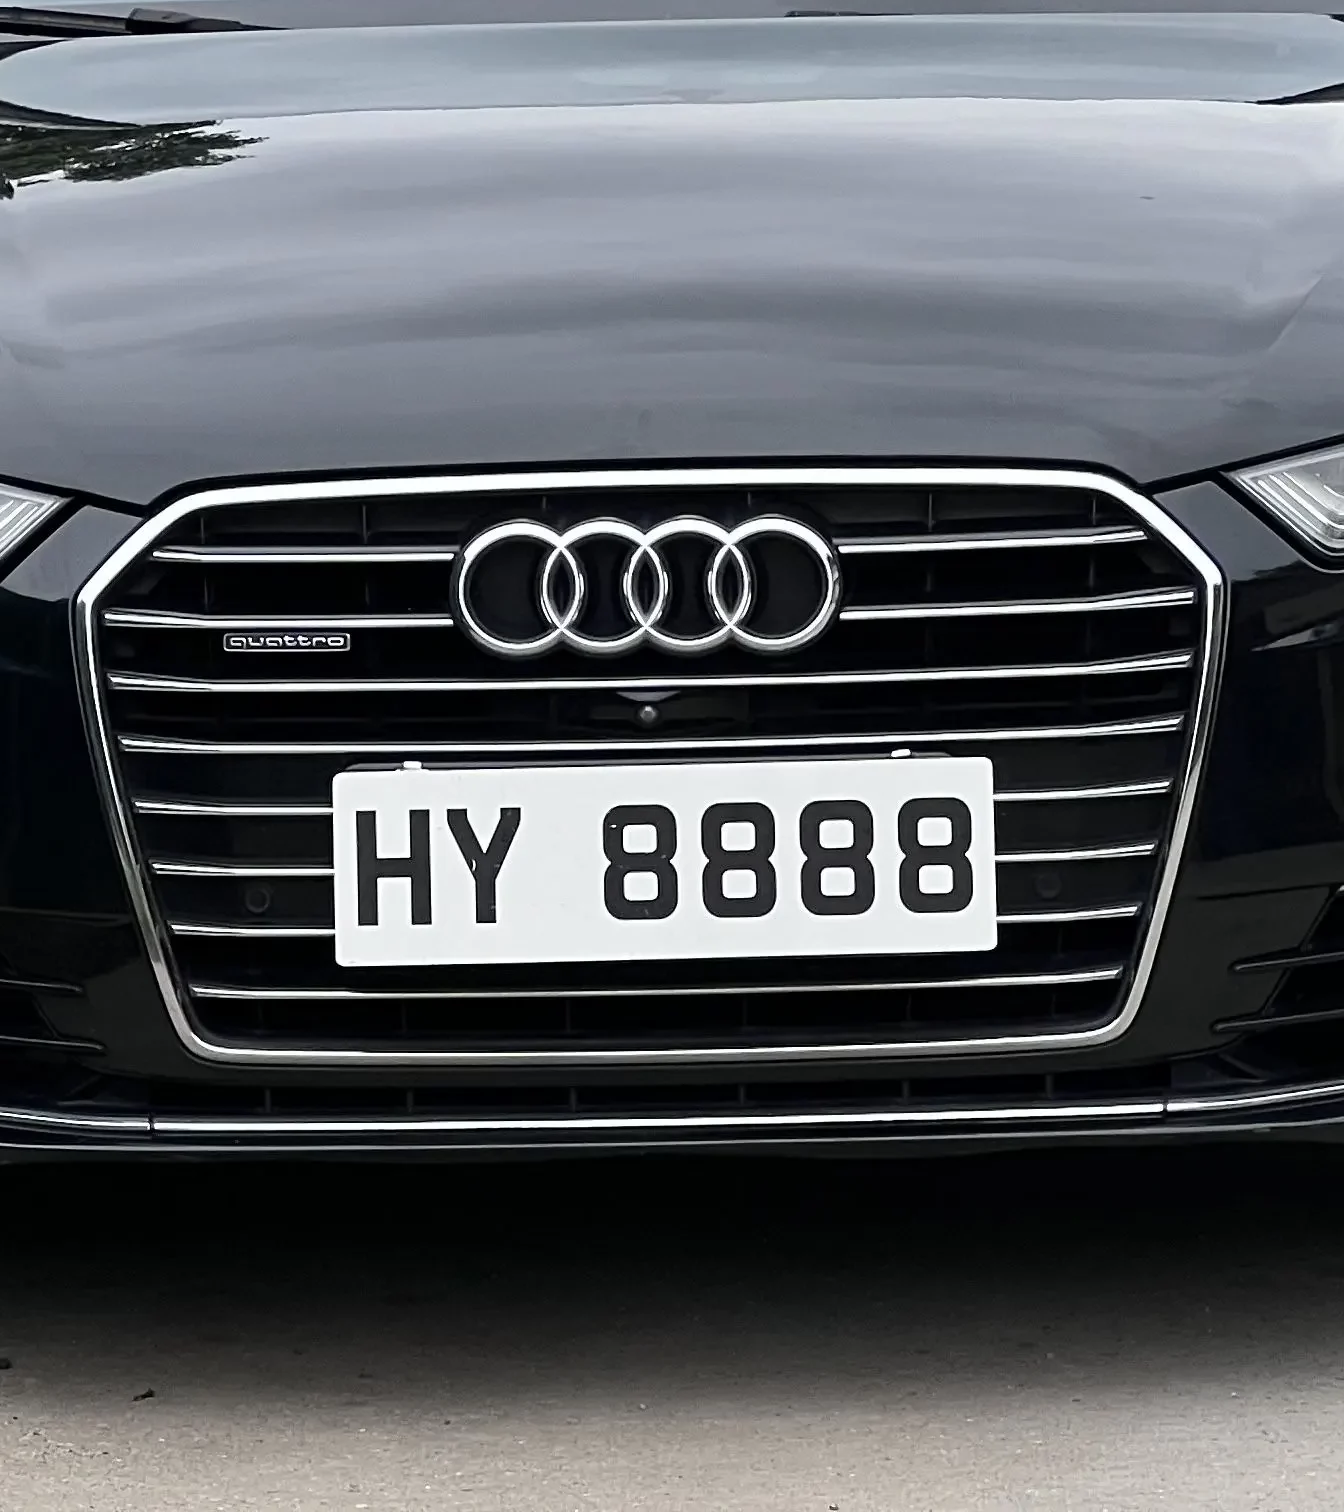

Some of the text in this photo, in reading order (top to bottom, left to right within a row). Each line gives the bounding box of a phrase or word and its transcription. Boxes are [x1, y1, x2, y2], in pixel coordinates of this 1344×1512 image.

[229, 635, 345, 650] quattro
[355, 797, 974, 926] HY 8888
